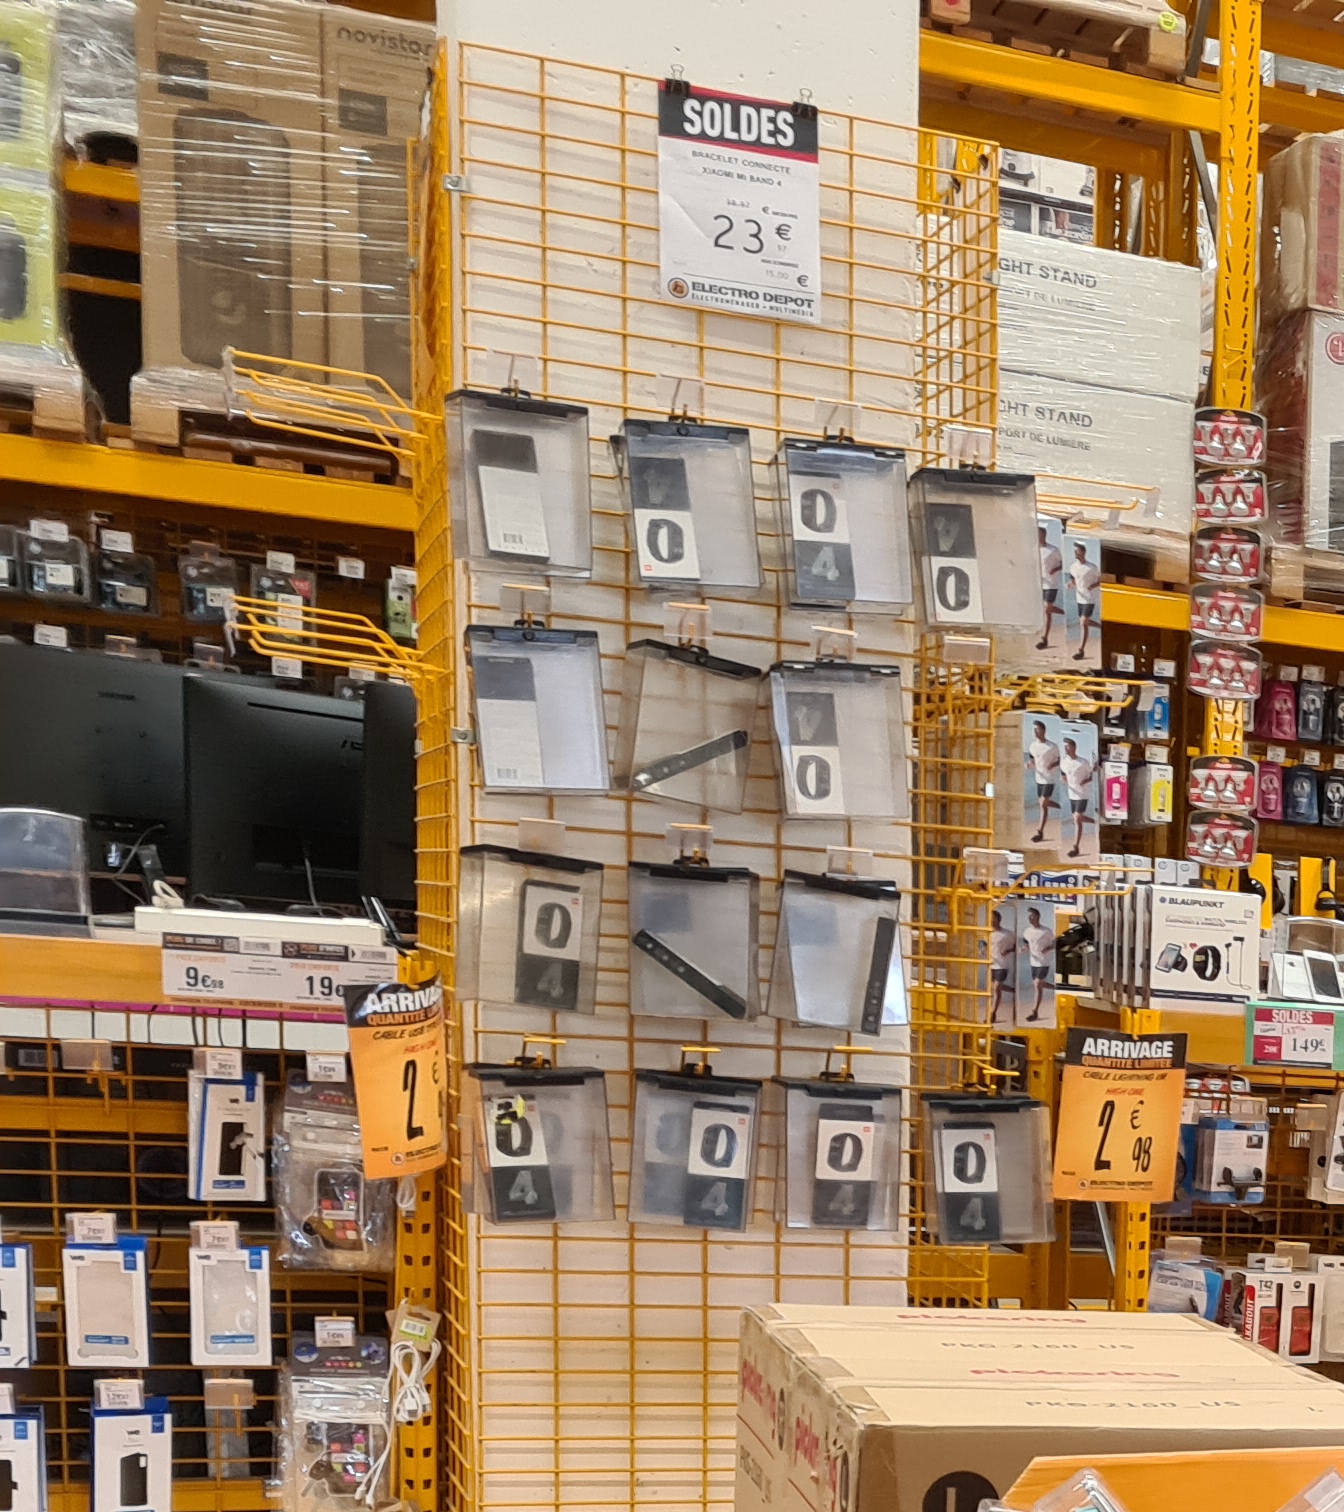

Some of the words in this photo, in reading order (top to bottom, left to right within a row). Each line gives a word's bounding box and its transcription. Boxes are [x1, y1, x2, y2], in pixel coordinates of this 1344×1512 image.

[336, 24, 433, 55] novistar
[683, 98, 795, 147] SOLDES
[713, 214, 765, 254] 23
[1038, 265, 1097, 289] STAND
[763, 292, 815, 310] DEPOT
[1034, 406, 1093, 428] STAND
[1168, 897, 1224, 909] BLAUPUNKT
[1081, 1037, 1174, 1059] ARRIVAGE
[402, 1059, 425, 1142] 2
[1093, 1100, 1115, 1171] 2
[1132, 1136, 1153, 1173] 98
